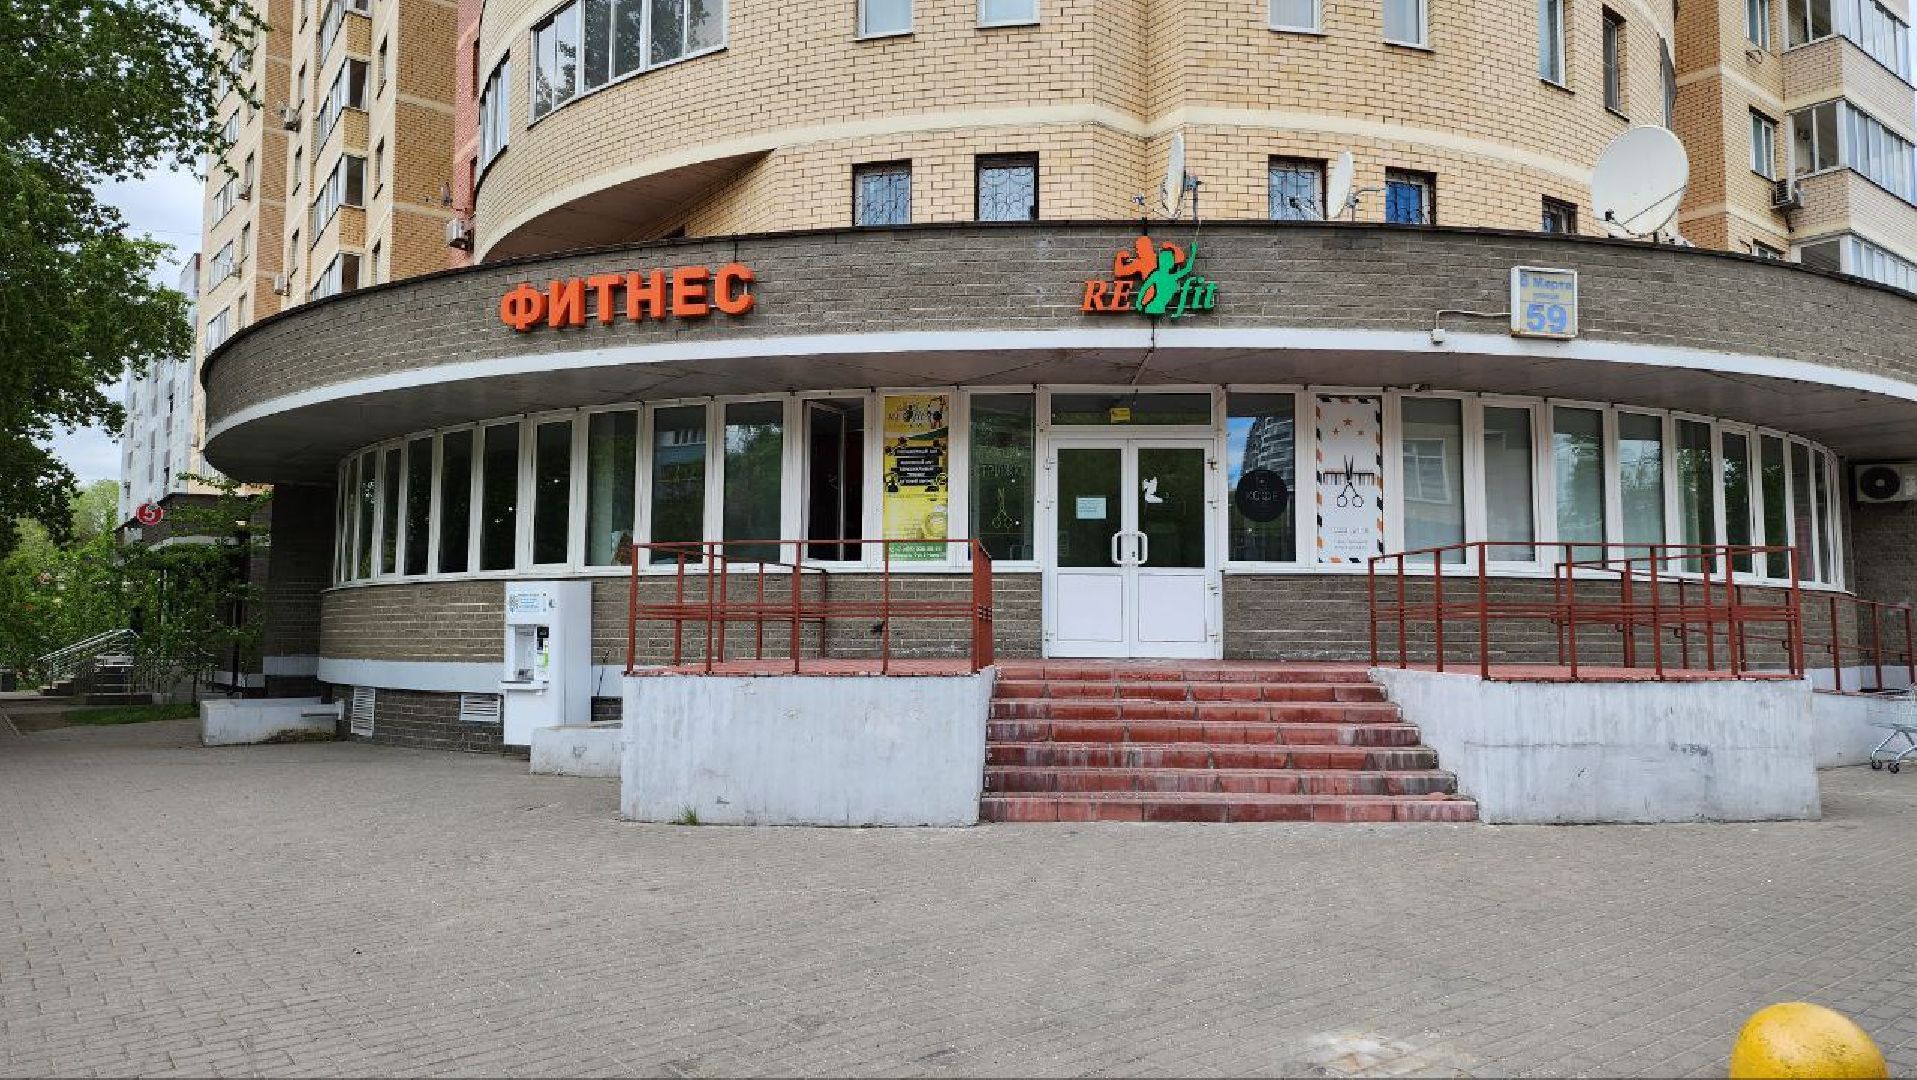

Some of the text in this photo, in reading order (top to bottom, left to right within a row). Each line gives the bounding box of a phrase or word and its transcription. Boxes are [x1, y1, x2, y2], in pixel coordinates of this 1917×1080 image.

[500, 263, 755, 331] ФИТНЕС
[1080, 276, 1218, 320] RE fit
[1527, 304, 1567, 332] 59
